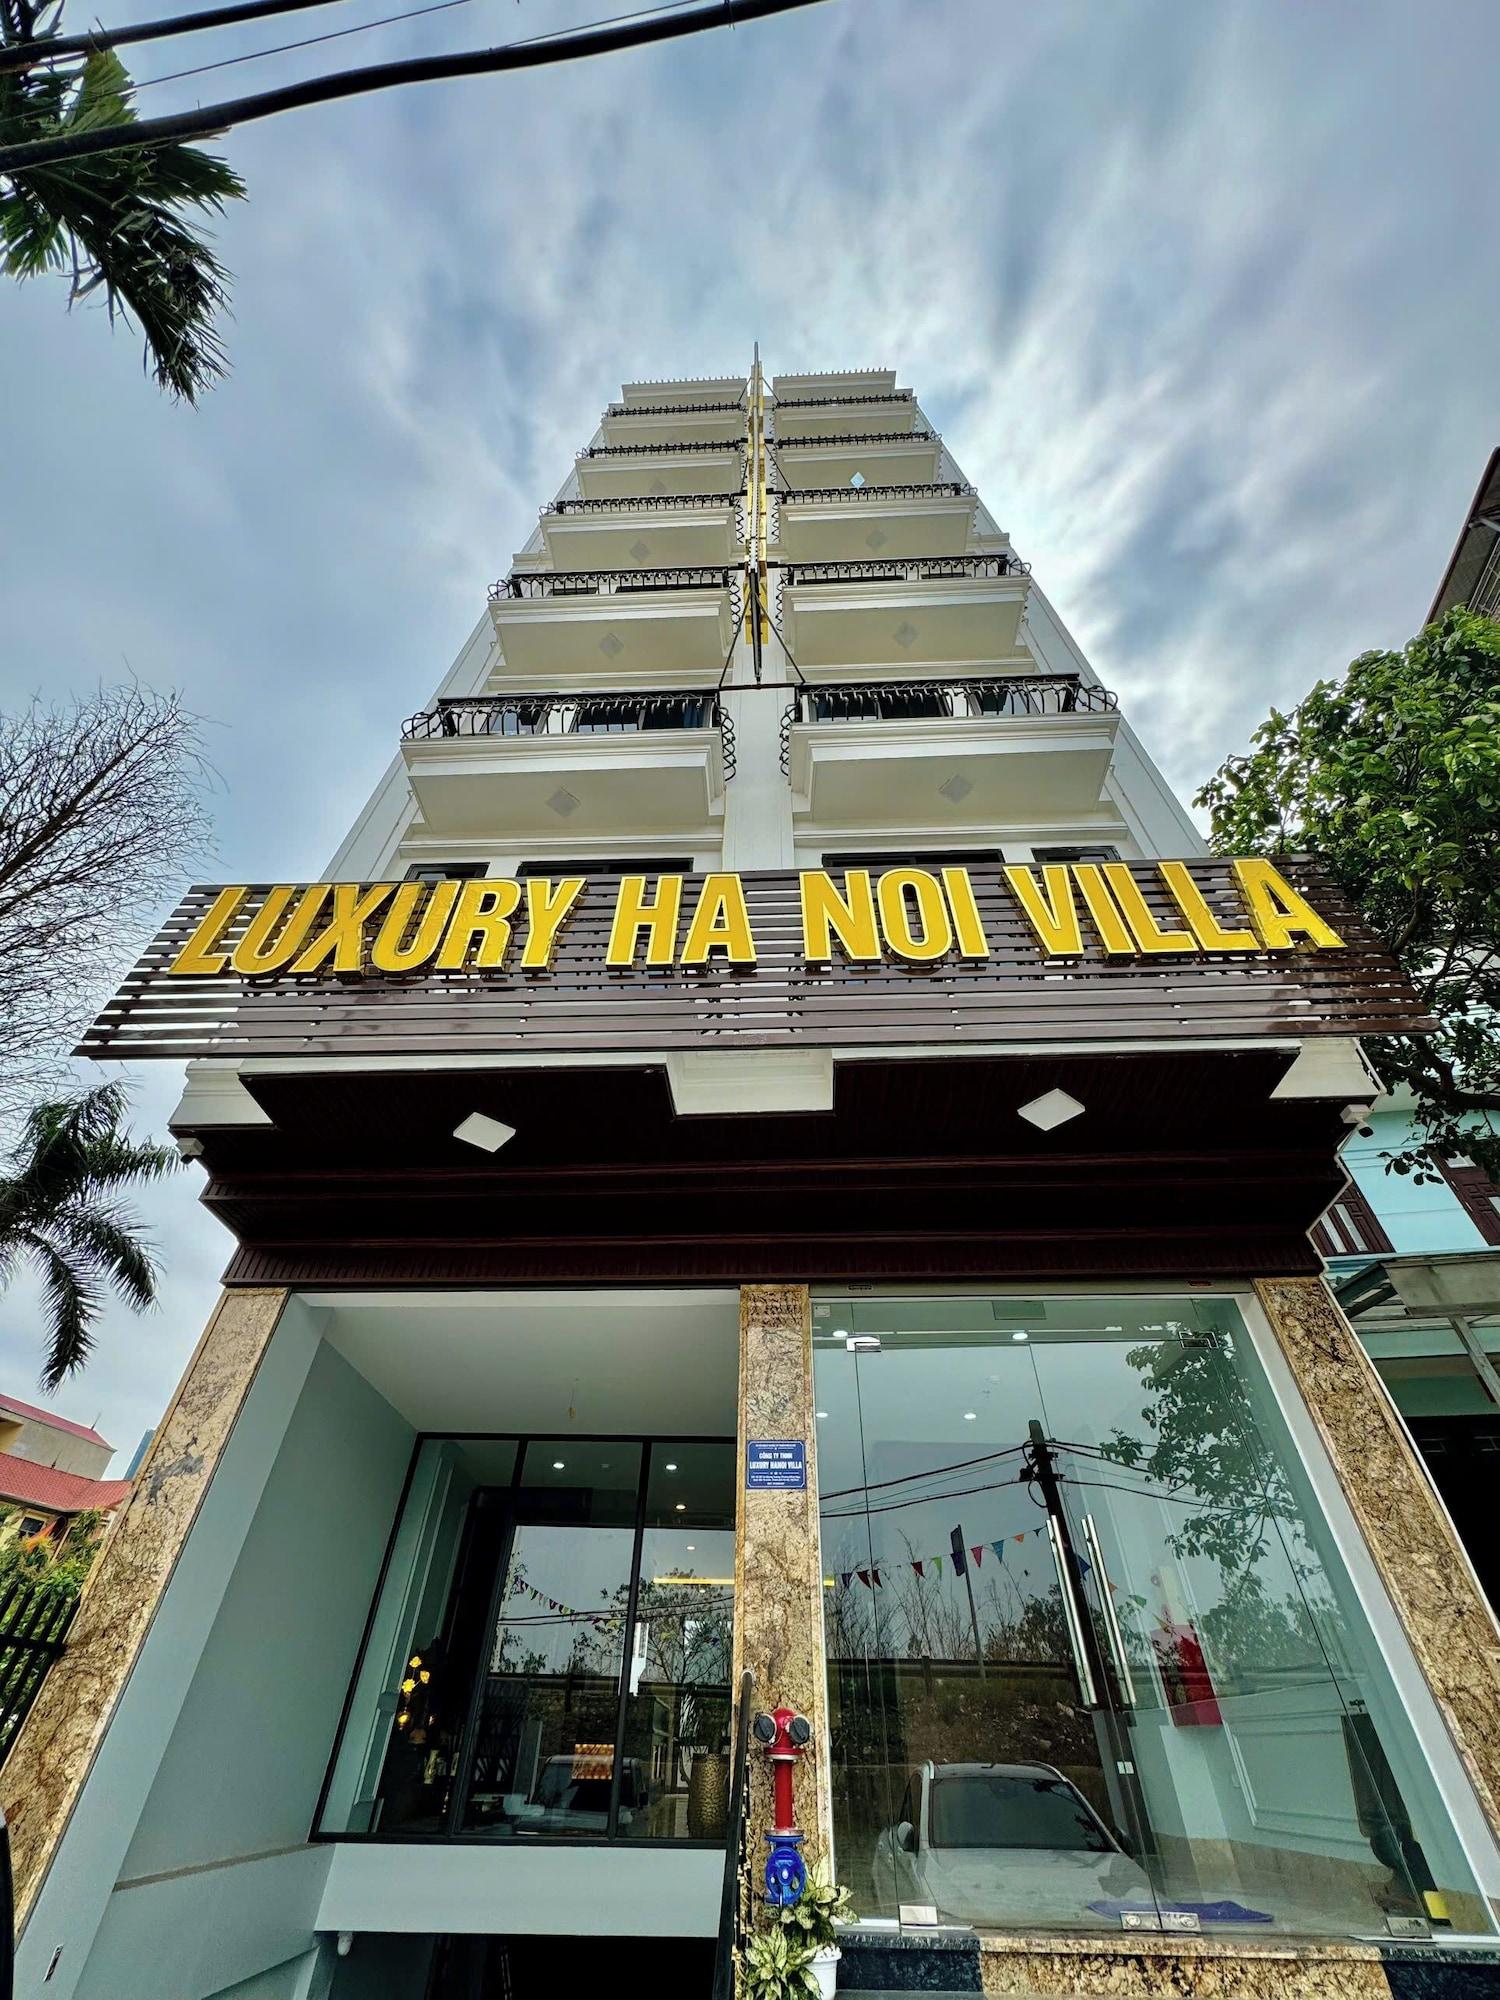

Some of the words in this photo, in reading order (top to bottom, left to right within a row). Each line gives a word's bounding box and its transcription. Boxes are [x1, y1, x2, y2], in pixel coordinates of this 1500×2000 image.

[169, 877, 587, 977] LUXURY
[605, 872, 757, 971] HA
[799, 867, 990, 963] NOI
[1003, 858, 1348, 958] VILLA
[750, 1461, 769, 1469] LUXURY
[788, 1461, 802, 1469] VILLA
